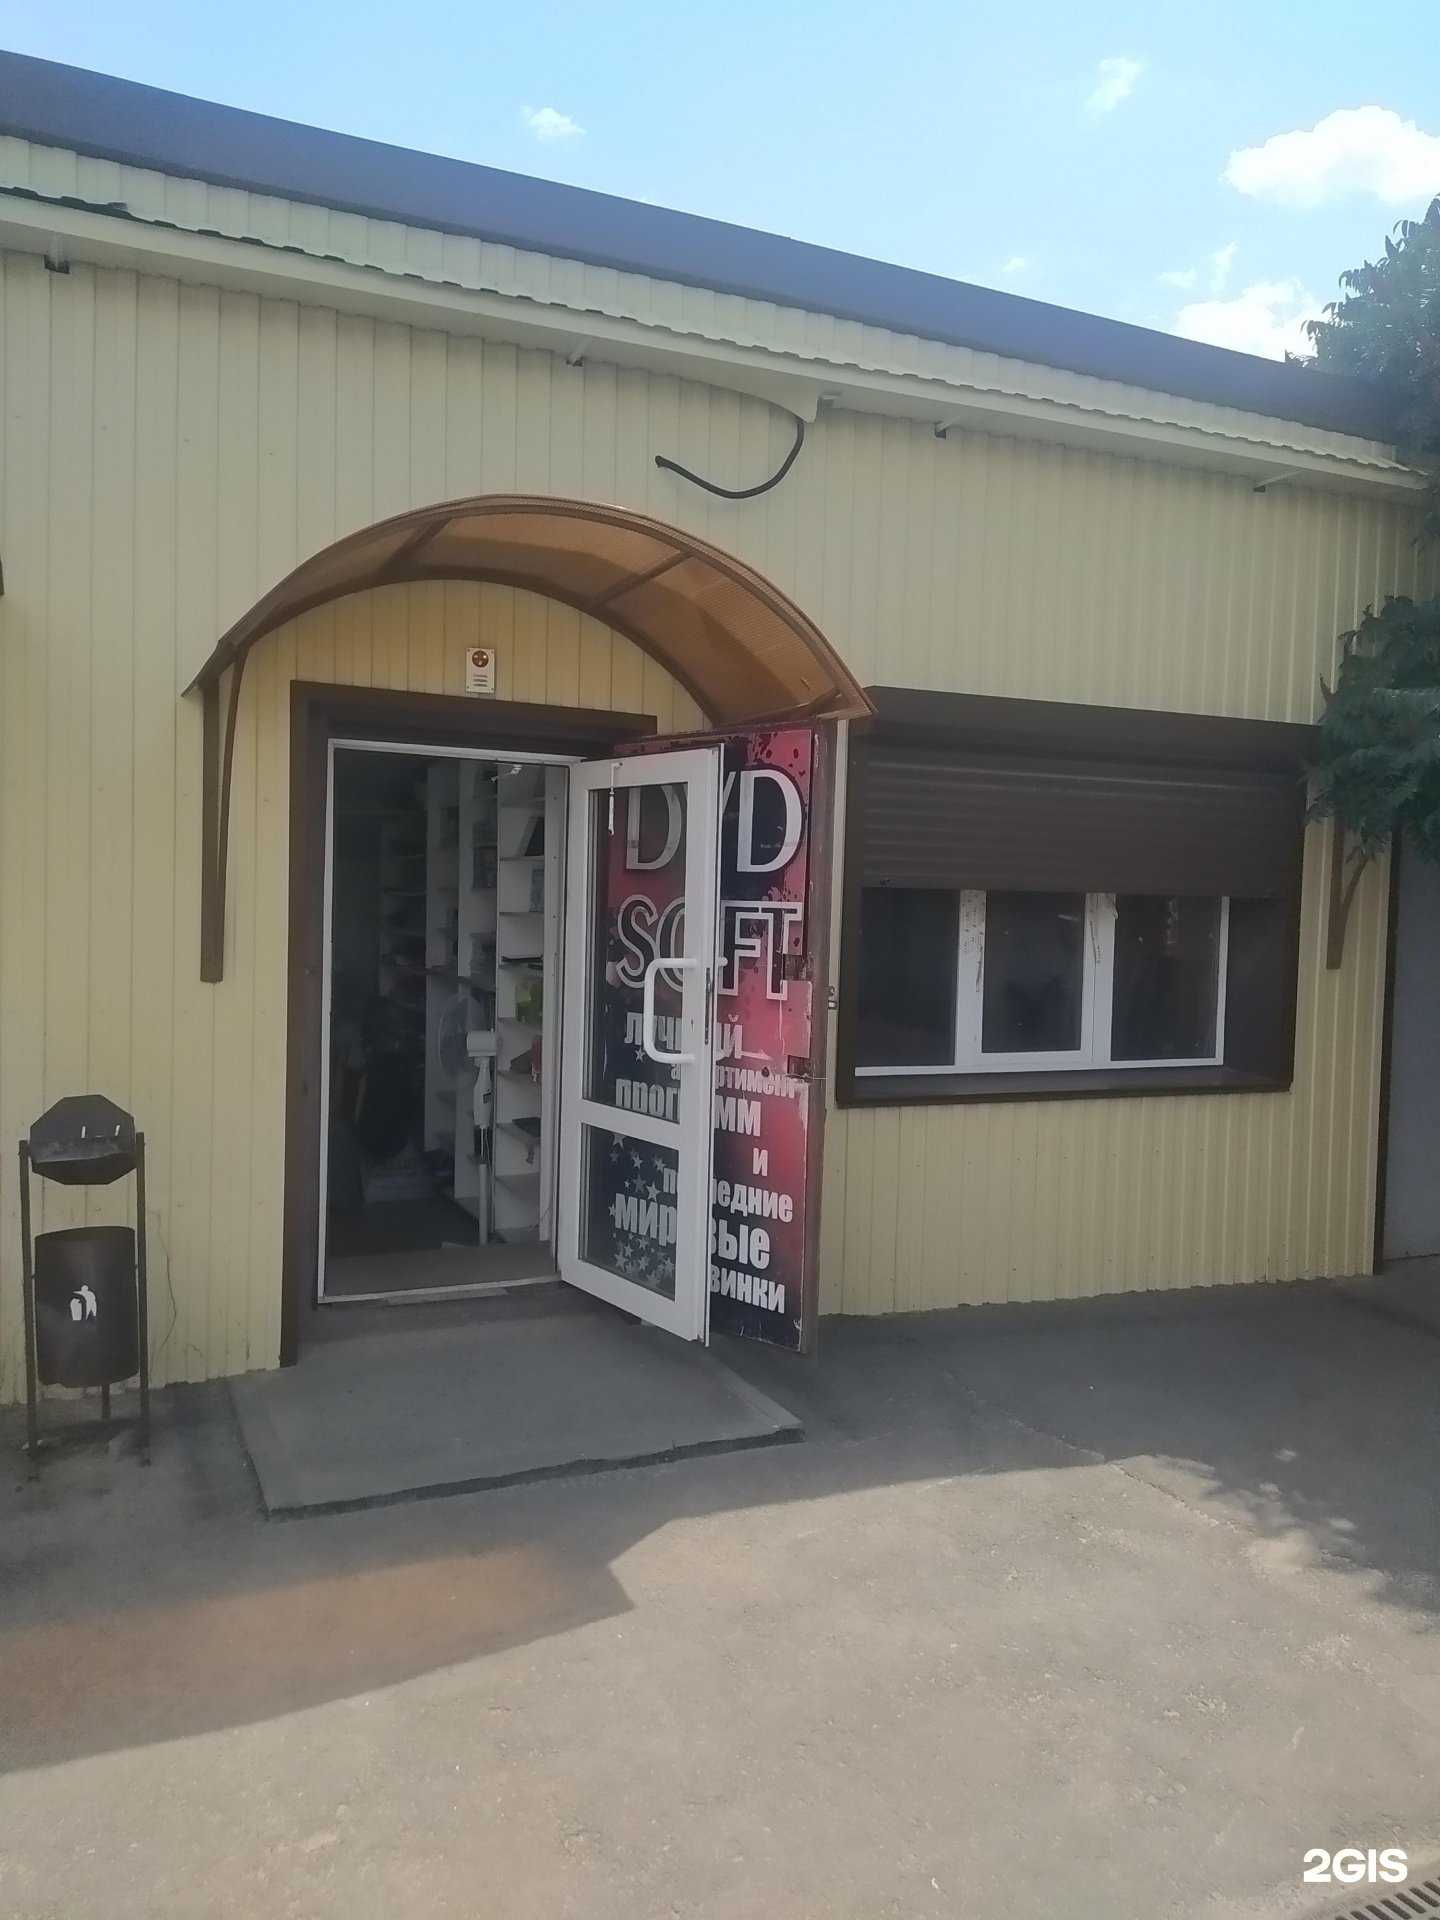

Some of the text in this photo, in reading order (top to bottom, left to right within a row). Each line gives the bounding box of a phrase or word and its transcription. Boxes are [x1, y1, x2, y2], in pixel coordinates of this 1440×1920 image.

[626, 769, 802, 873] DD
[615, 1078, 761, 1136] прогмм
[663, 1168, 793, 1223] педние
[615, 1193, 770, 1269] мирые
[711, 1265, 785, 1313] винки
